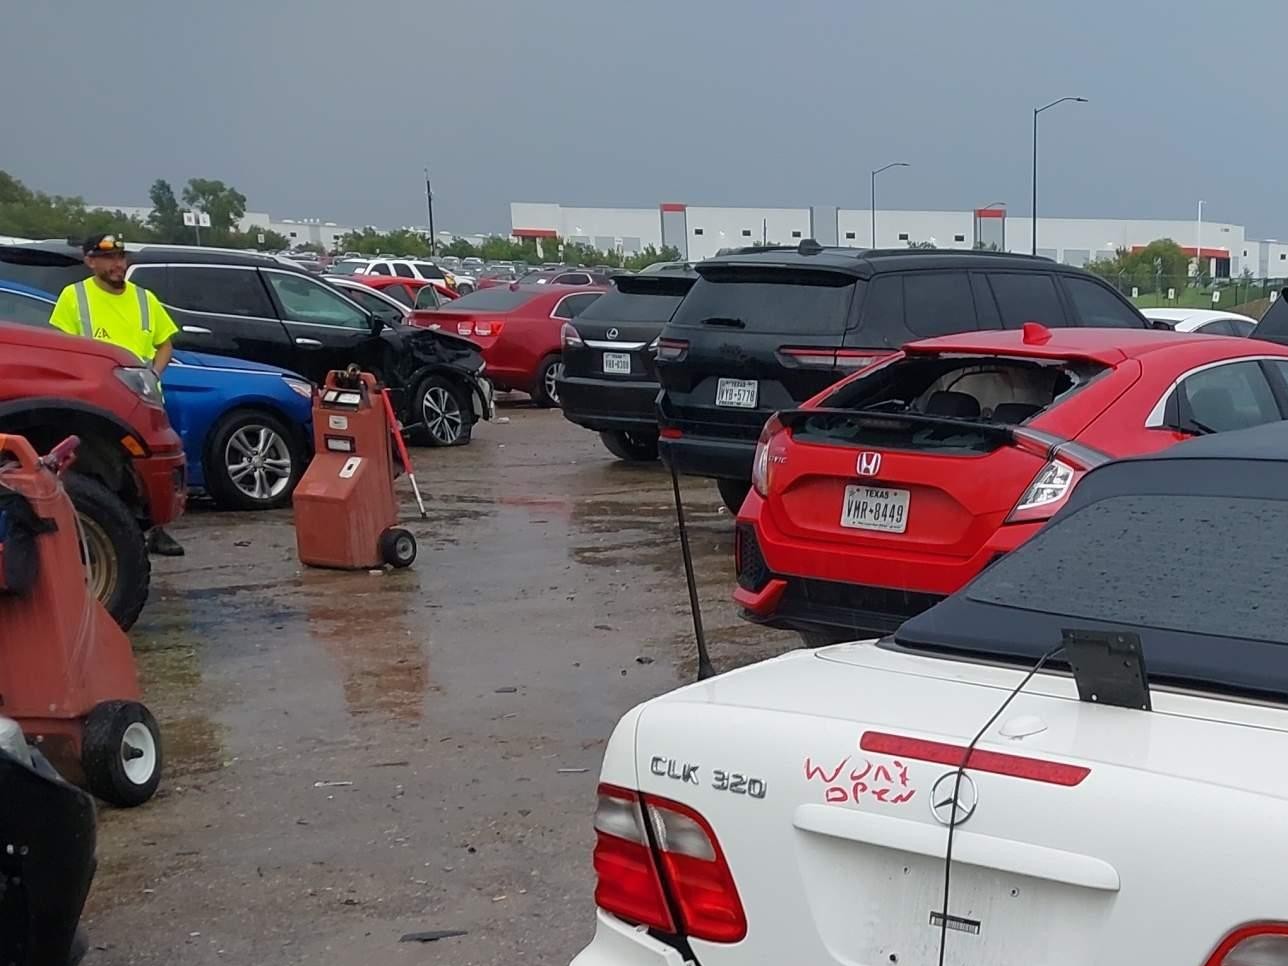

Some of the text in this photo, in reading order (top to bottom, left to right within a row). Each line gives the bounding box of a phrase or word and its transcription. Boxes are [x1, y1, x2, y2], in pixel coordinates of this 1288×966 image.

[865, 489, 889, 499] TEXAS
[650, 756, 767, 799] CLK 320
